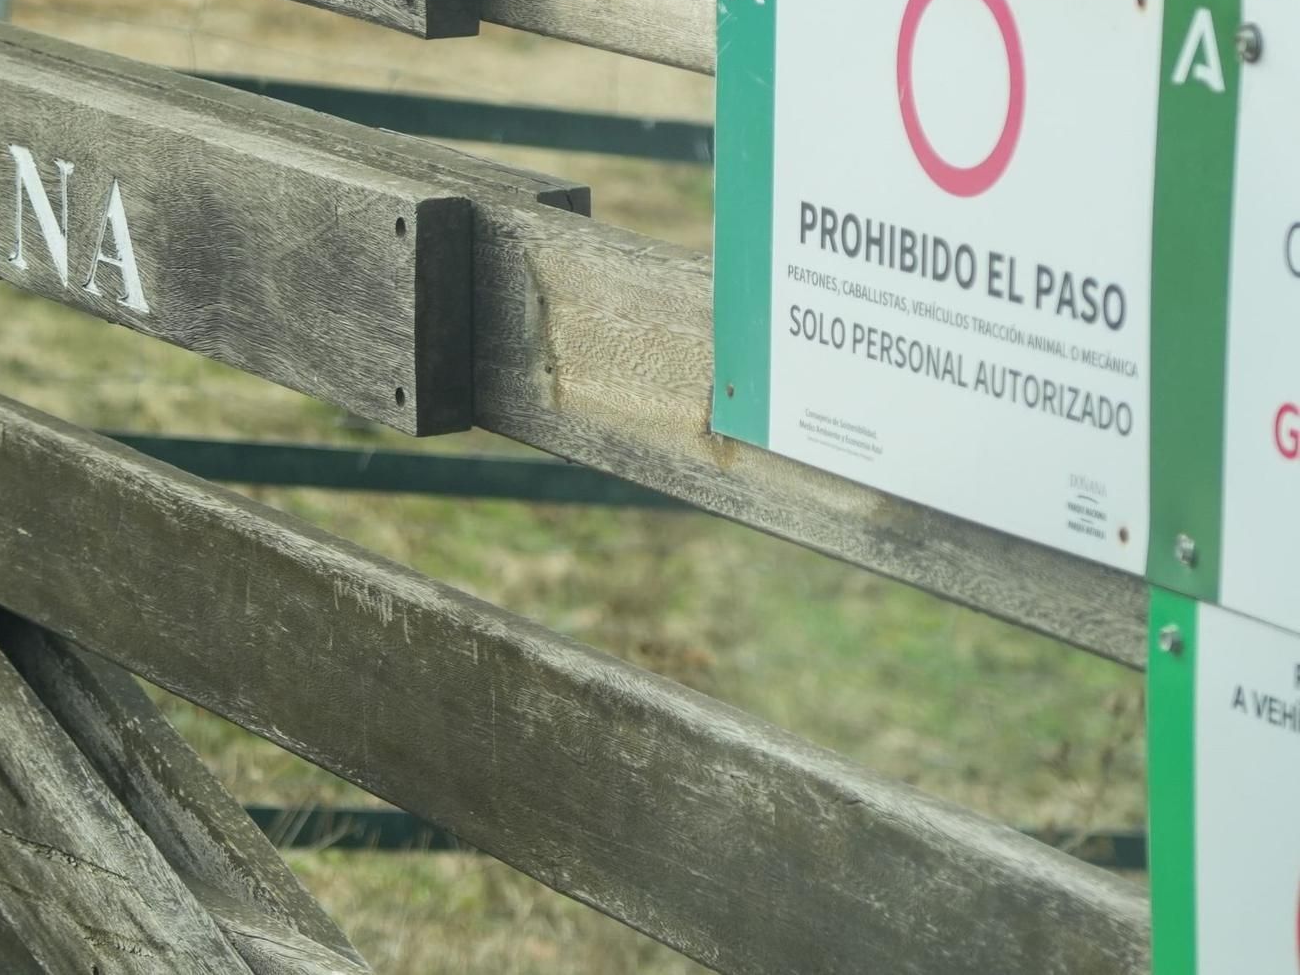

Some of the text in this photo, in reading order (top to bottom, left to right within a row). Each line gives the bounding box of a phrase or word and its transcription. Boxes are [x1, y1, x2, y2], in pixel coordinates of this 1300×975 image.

[787, 264, 841, 296] PEATONES,
[842, 280, 910, 316] CABALLISTAS,
[912, 299, 970, 330] VEHÍCULOS
[972, 316, 1025, 346] TRACCIÓN
[1027, 333, 1069, 359] ANIMAL
[1081, 348, 1140, 378] MECÁNICA
[799, 200, 1127, 331] PROHIBIDO EL PASO
[789, 304, 1133, 437] SOLO PERSONAL AUTORIZADO
[1229, 683, 1249, 715] A
